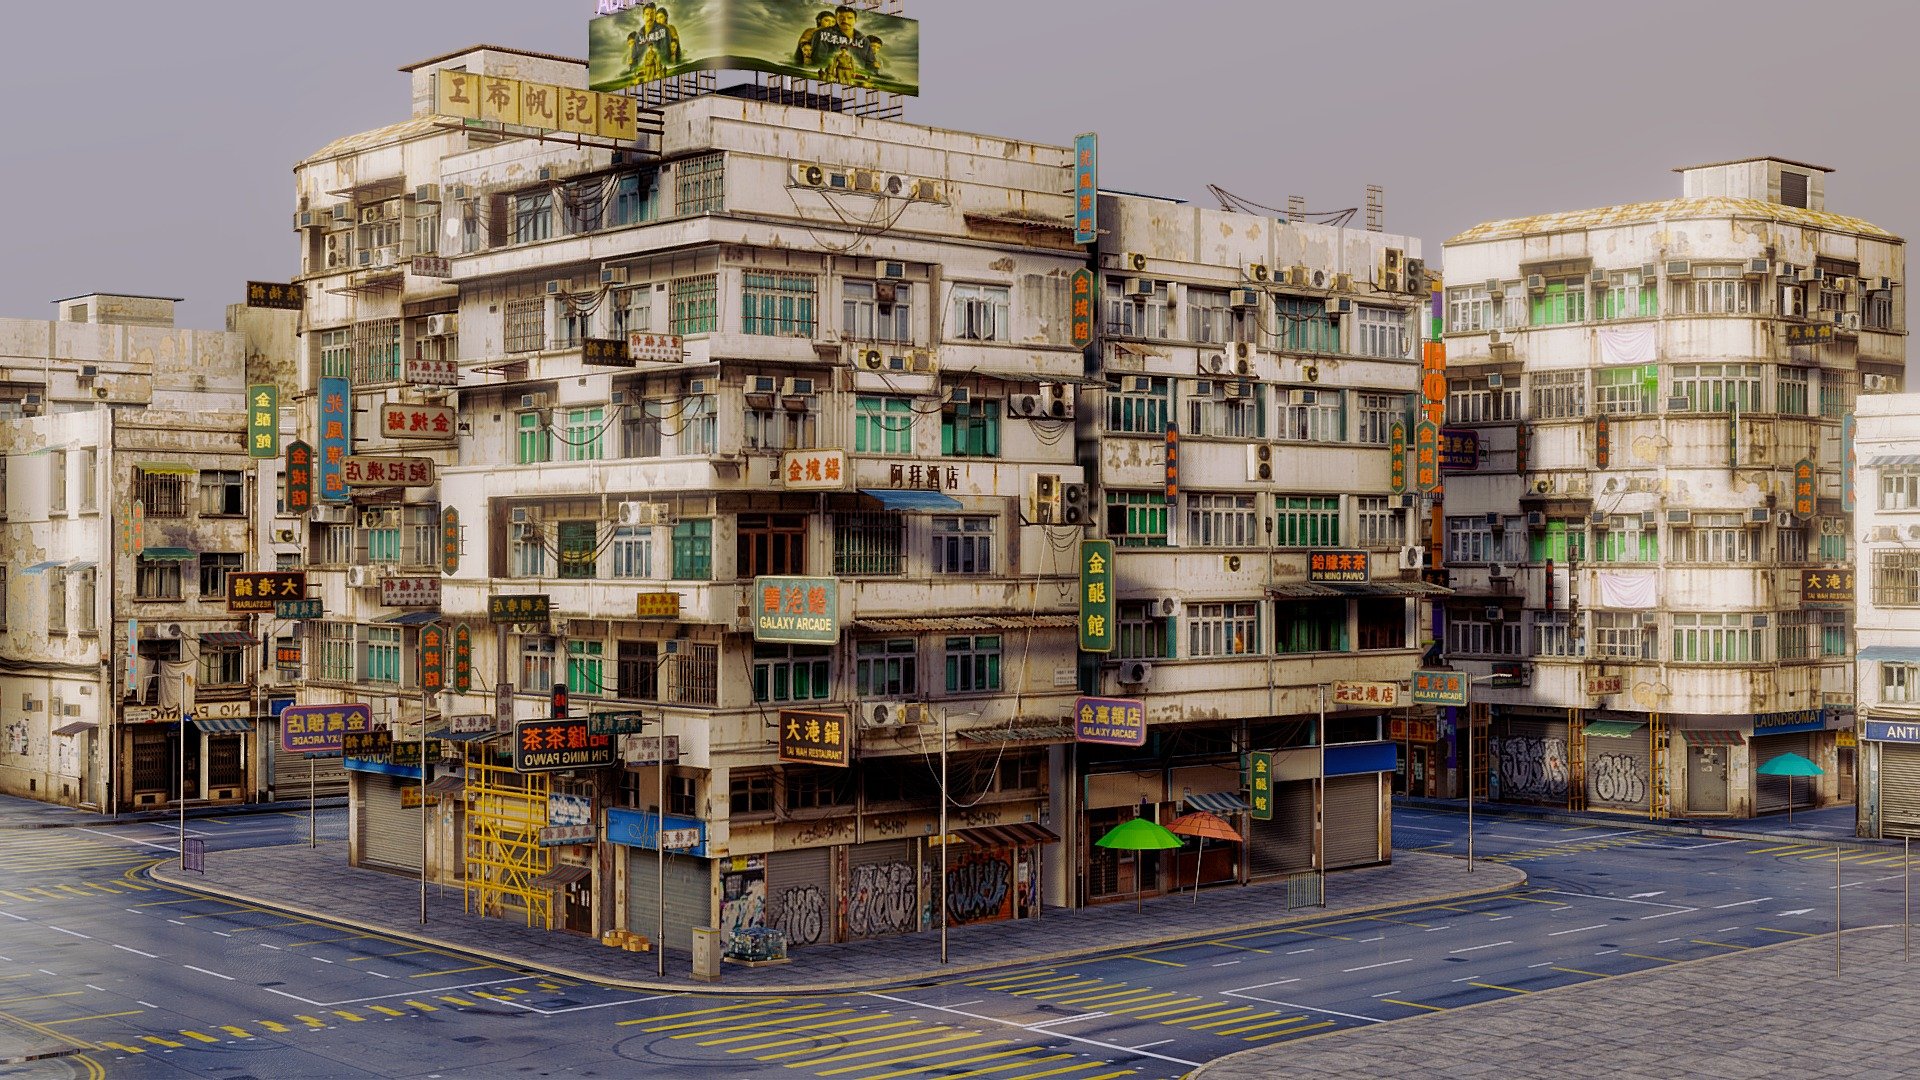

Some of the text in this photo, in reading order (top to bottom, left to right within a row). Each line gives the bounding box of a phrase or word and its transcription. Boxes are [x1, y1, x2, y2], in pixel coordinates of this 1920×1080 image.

[760, 616, 832, 632] GALAXY ARCADE
[1754, 709, 1822, 729] LAUNDROMAT
